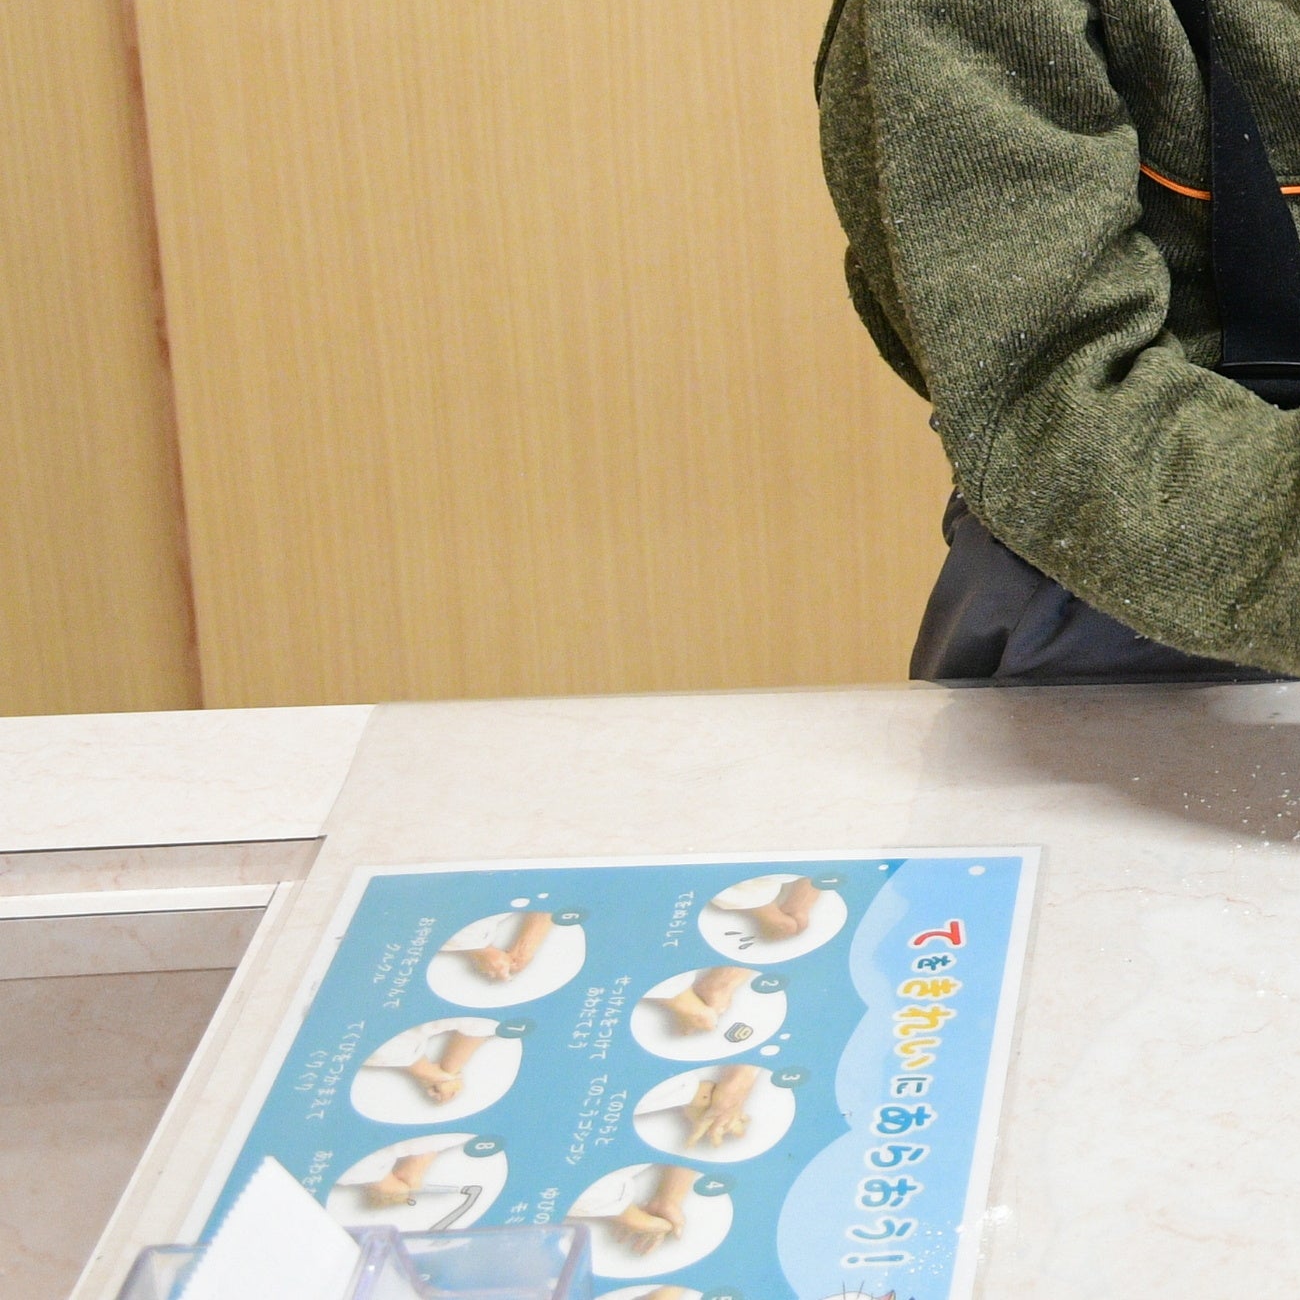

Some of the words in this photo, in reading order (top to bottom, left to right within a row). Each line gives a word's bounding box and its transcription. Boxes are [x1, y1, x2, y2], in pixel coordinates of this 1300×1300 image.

[662, 890, 695, 948] てをぬらして
[589, 974, 632, 1061] せっけんをつけて
[474, 1141, 496, 1152] 8
[594, 1089, 628, 1147] てのひらと
[302, 1150, 334, 1195] あわを
